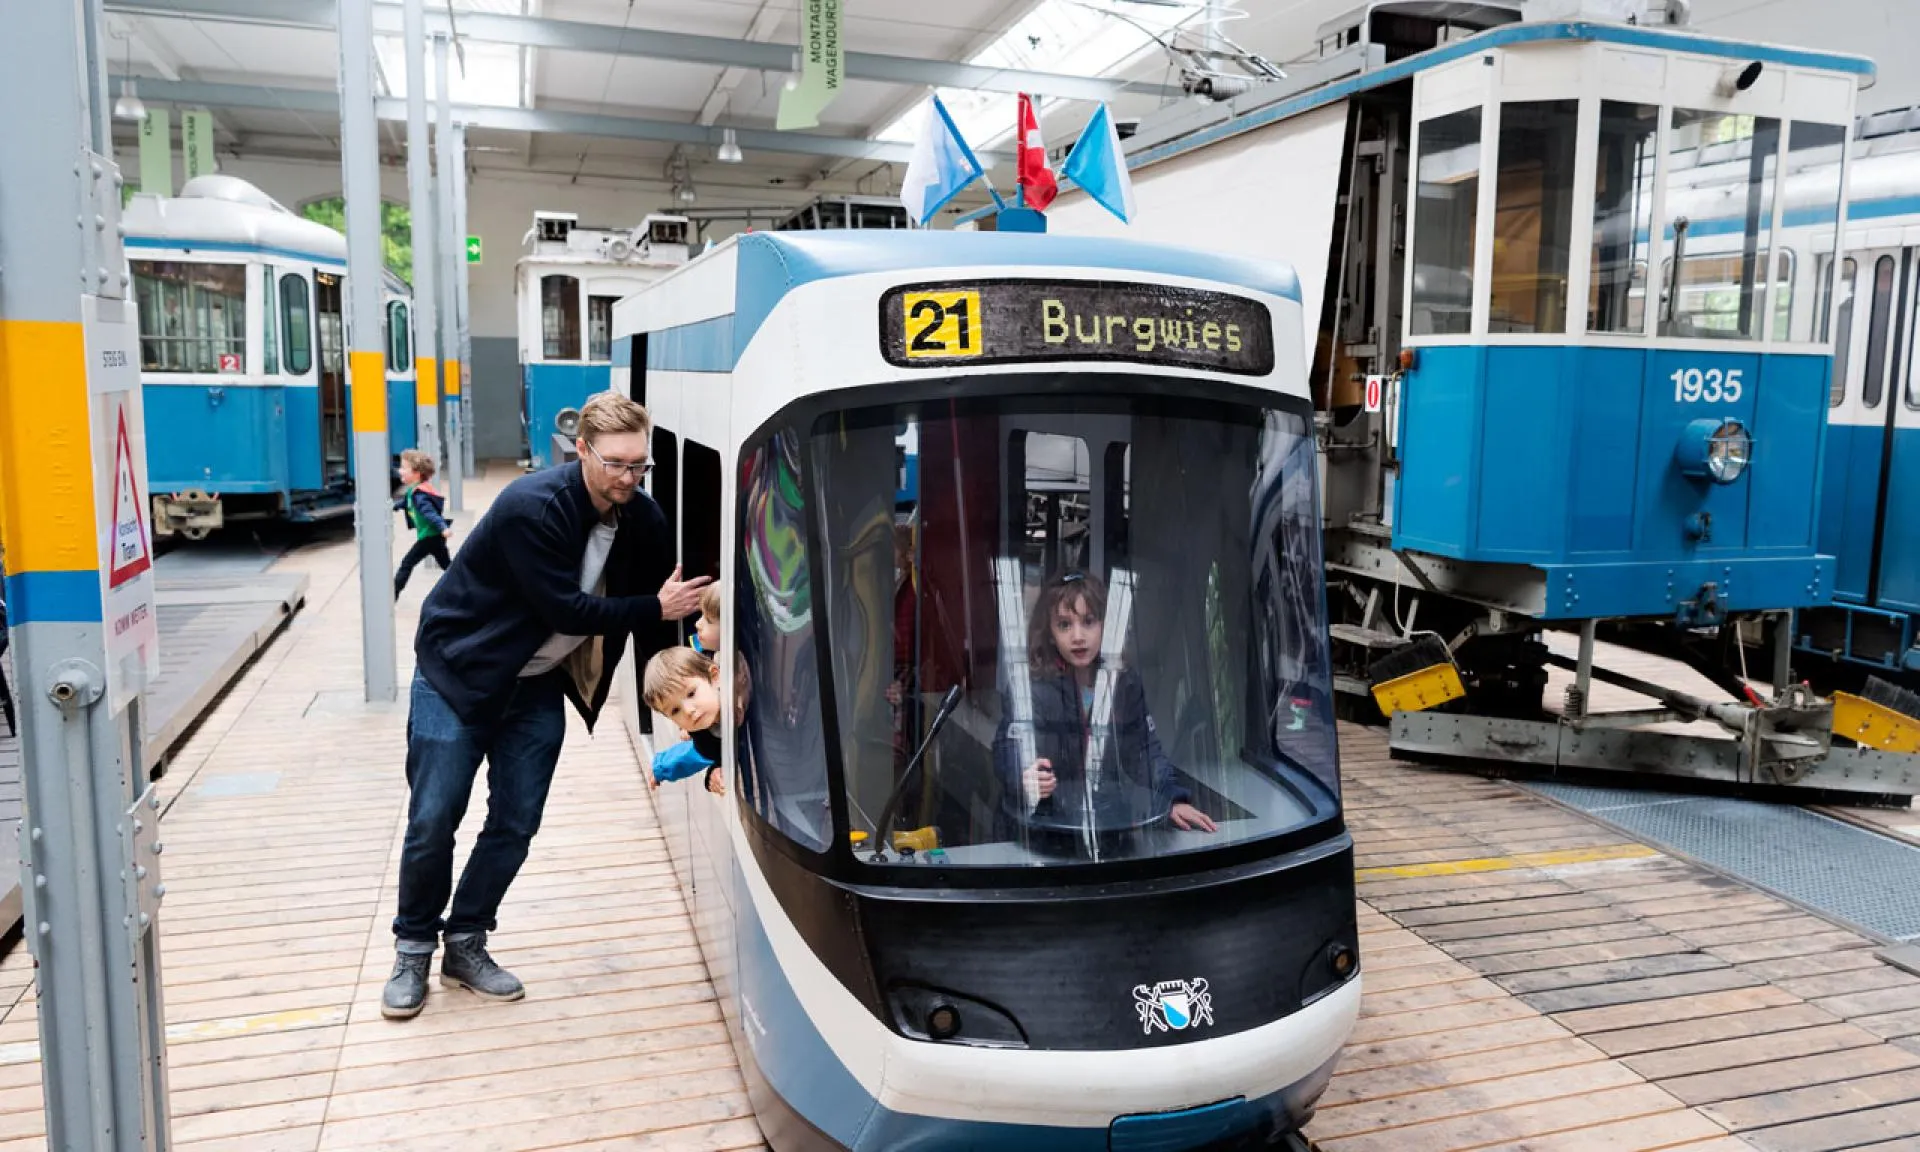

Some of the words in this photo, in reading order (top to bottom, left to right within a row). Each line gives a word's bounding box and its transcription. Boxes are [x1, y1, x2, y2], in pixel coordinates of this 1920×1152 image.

[809, 0, 822, 63] MONTAG
[910, 298, 971, 352] 21
[1042, 300, 1242, 351] Burgwies
[224, 356, 237, 370] 2
[1670, 368, 1743, 403] 1935
